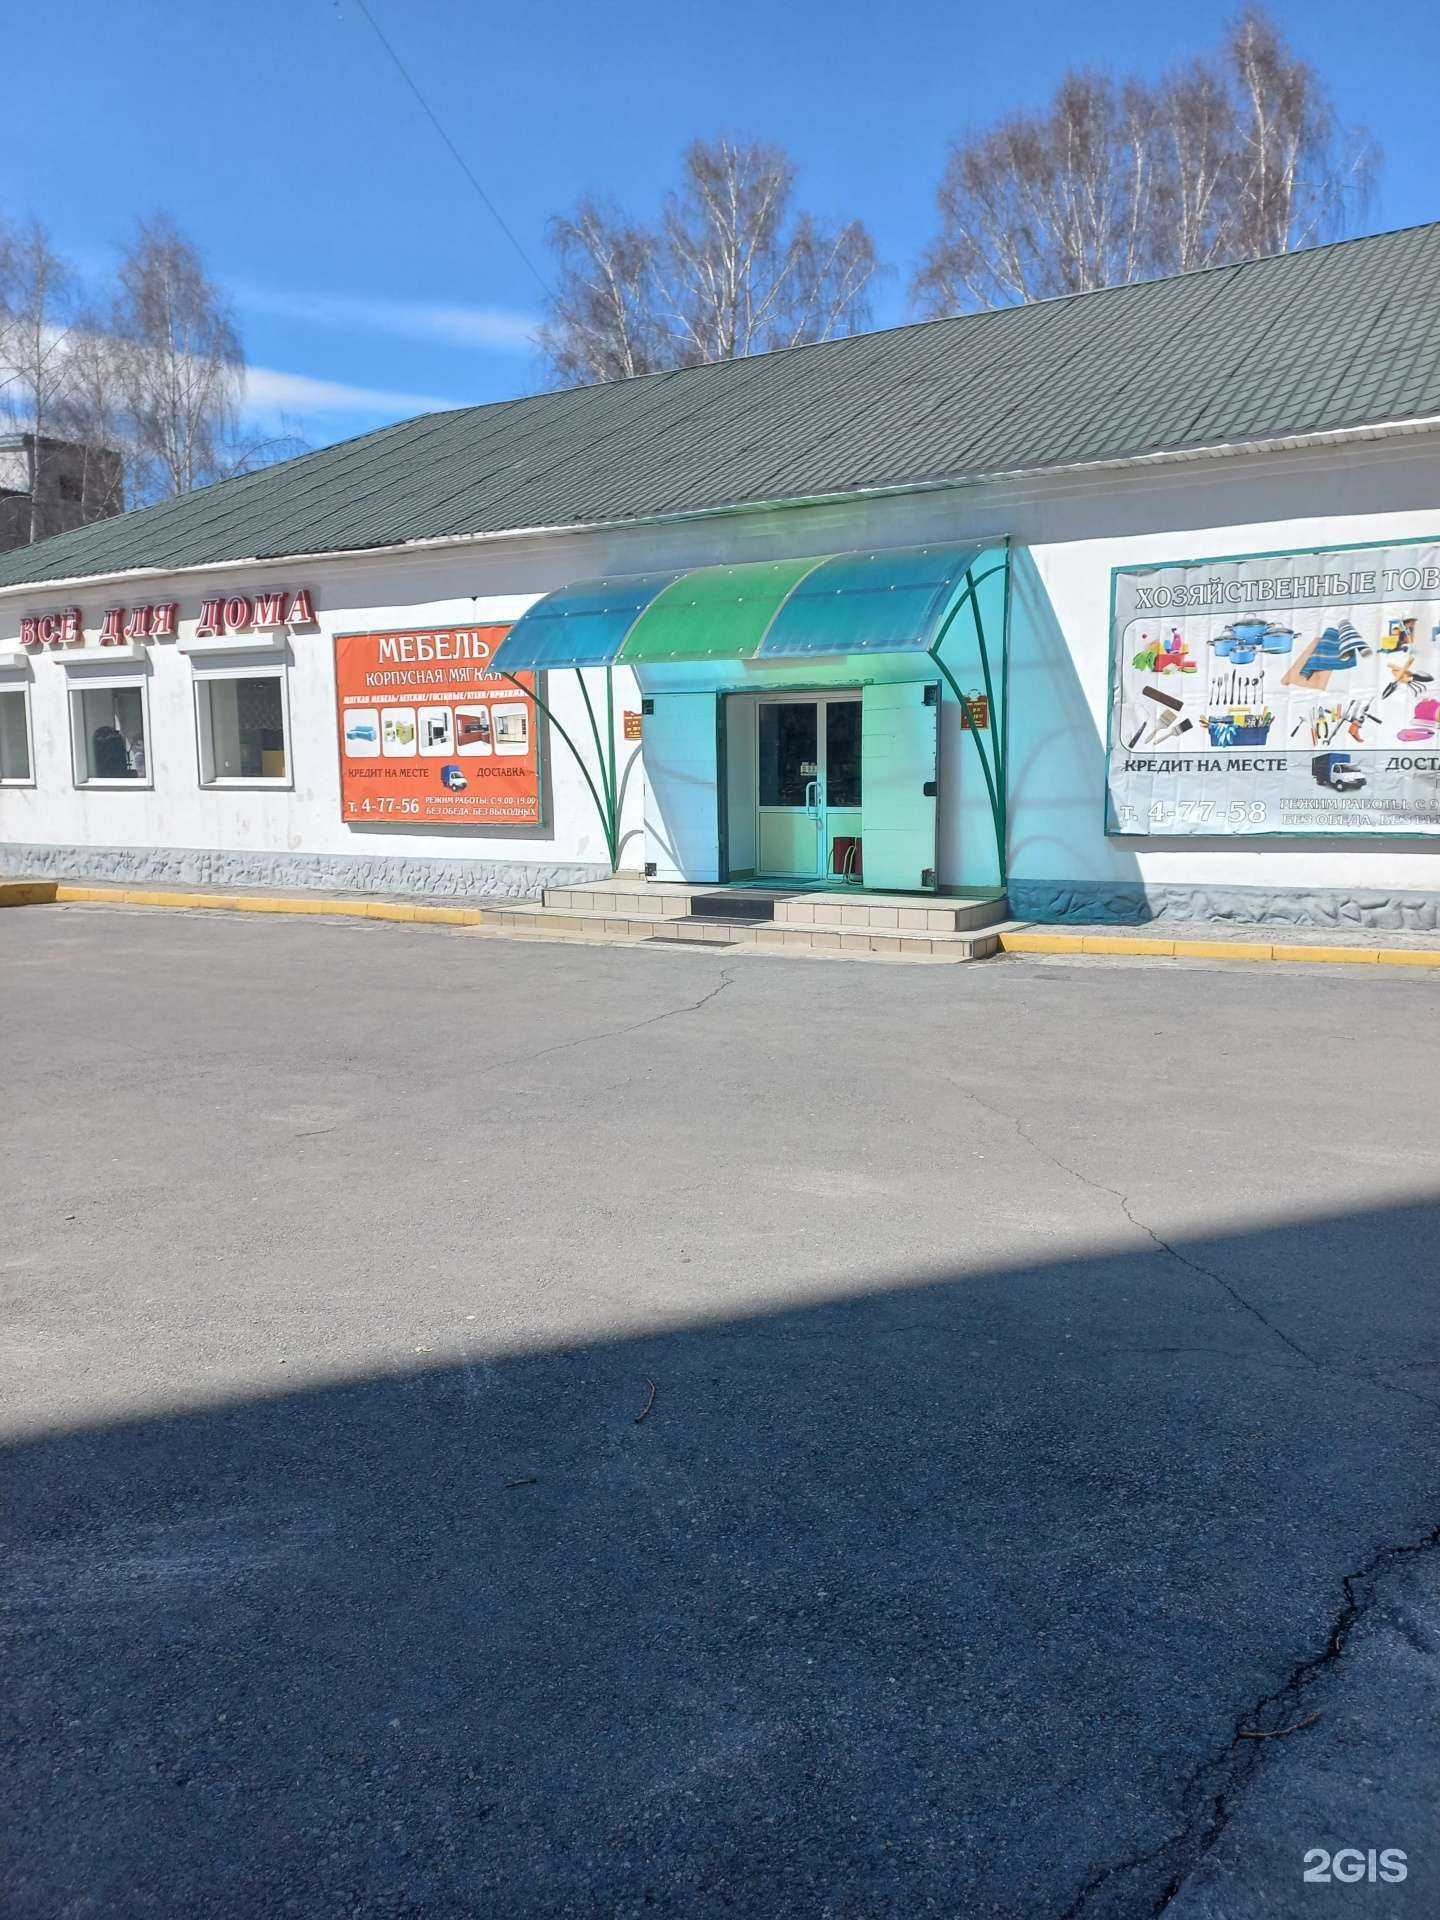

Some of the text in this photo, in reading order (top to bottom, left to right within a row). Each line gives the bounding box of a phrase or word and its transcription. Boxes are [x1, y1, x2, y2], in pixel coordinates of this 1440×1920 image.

[1136, 571, 1377, 610] ХОЗЯЙСТВЕННЫЕ
[19, 588, 318, 647] ВСЁ ДЛЯ ДОМА
[378, 632, 490, 664] МЕБЕЛЬ
[365, 669, 443, 687] КОРПУСНАЯ
[476, 767, 525, 777] ДОСТАВКА
[1123, 757, 1288, 774] КРЕДИТ НА МЕСТЕ
[1385, 756, 1440, 772] ДОСТ
[347, 768, 430, 778] КРЕДИТ НА МЕСТЕ
[361, 797, 420, 814] 4-77-56
[1147, 800, 1267, 824] 4-77-58
[1280, 798, 1338, 810] РЕЖИМ
